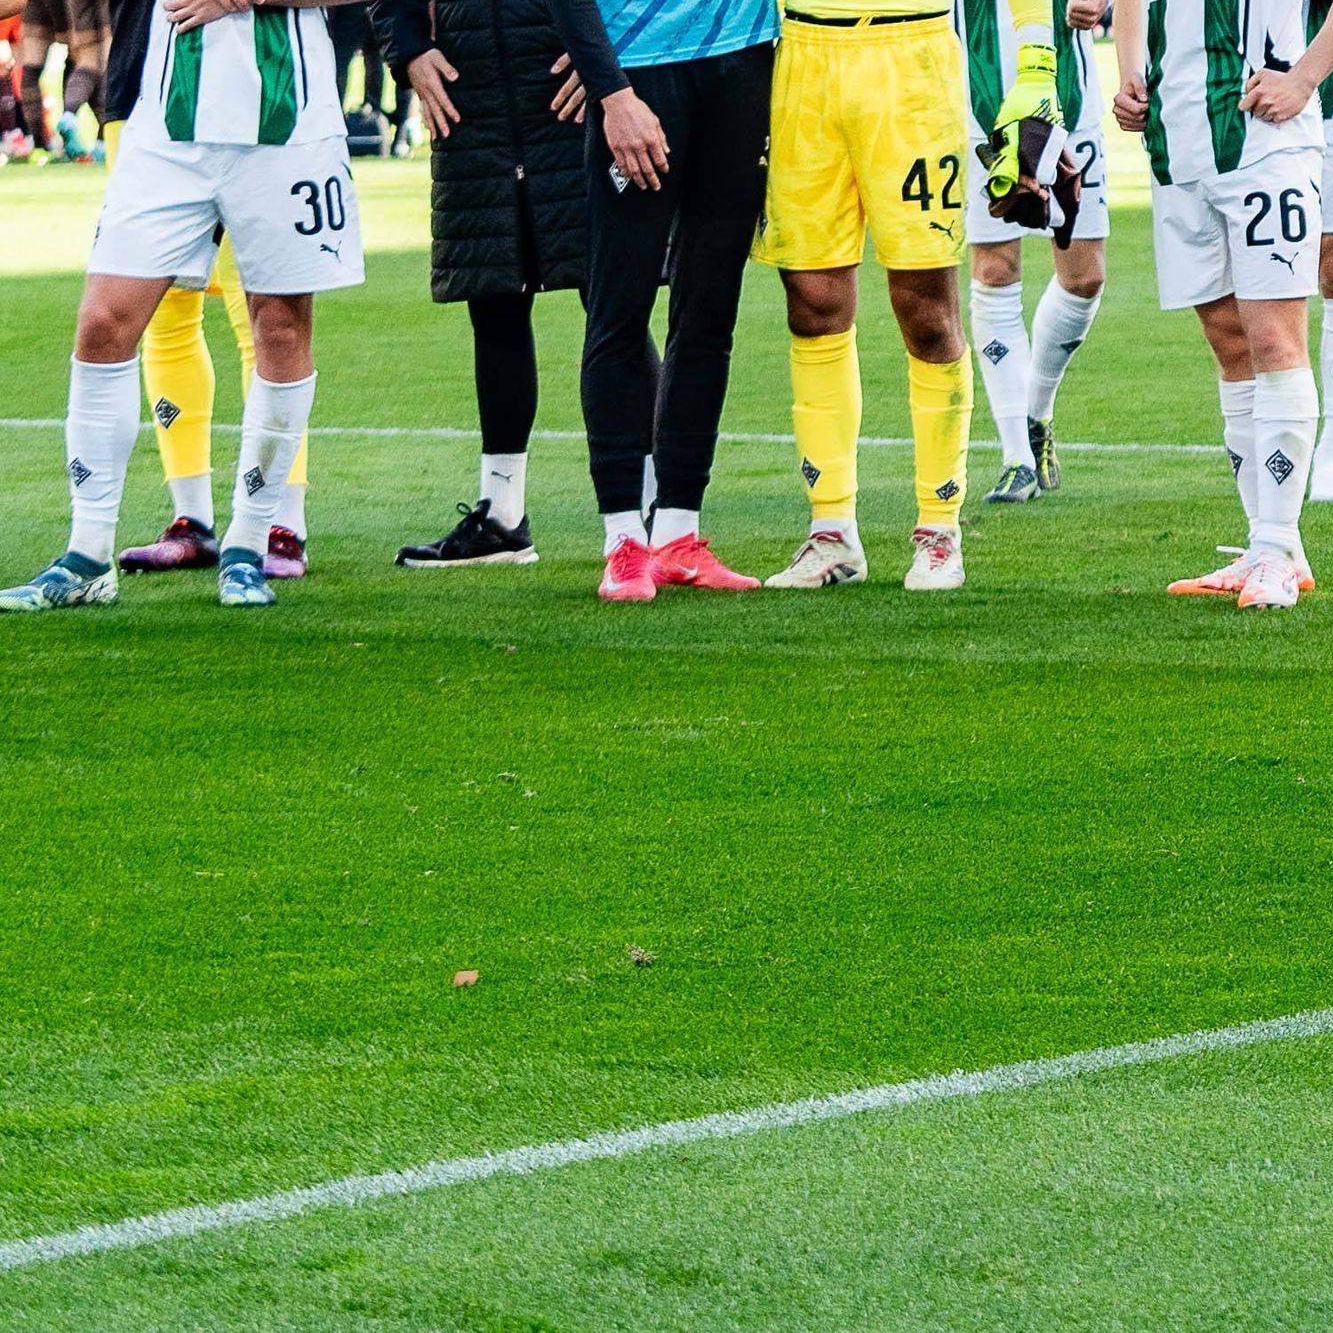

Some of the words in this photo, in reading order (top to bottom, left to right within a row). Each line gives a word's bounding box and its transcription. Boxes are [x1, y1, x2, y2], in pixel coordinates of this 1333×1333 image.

[292, 176, 346, 236] 30
[901, 154, 963, 212] 42
[1245, 187, 1308, 248] 26
